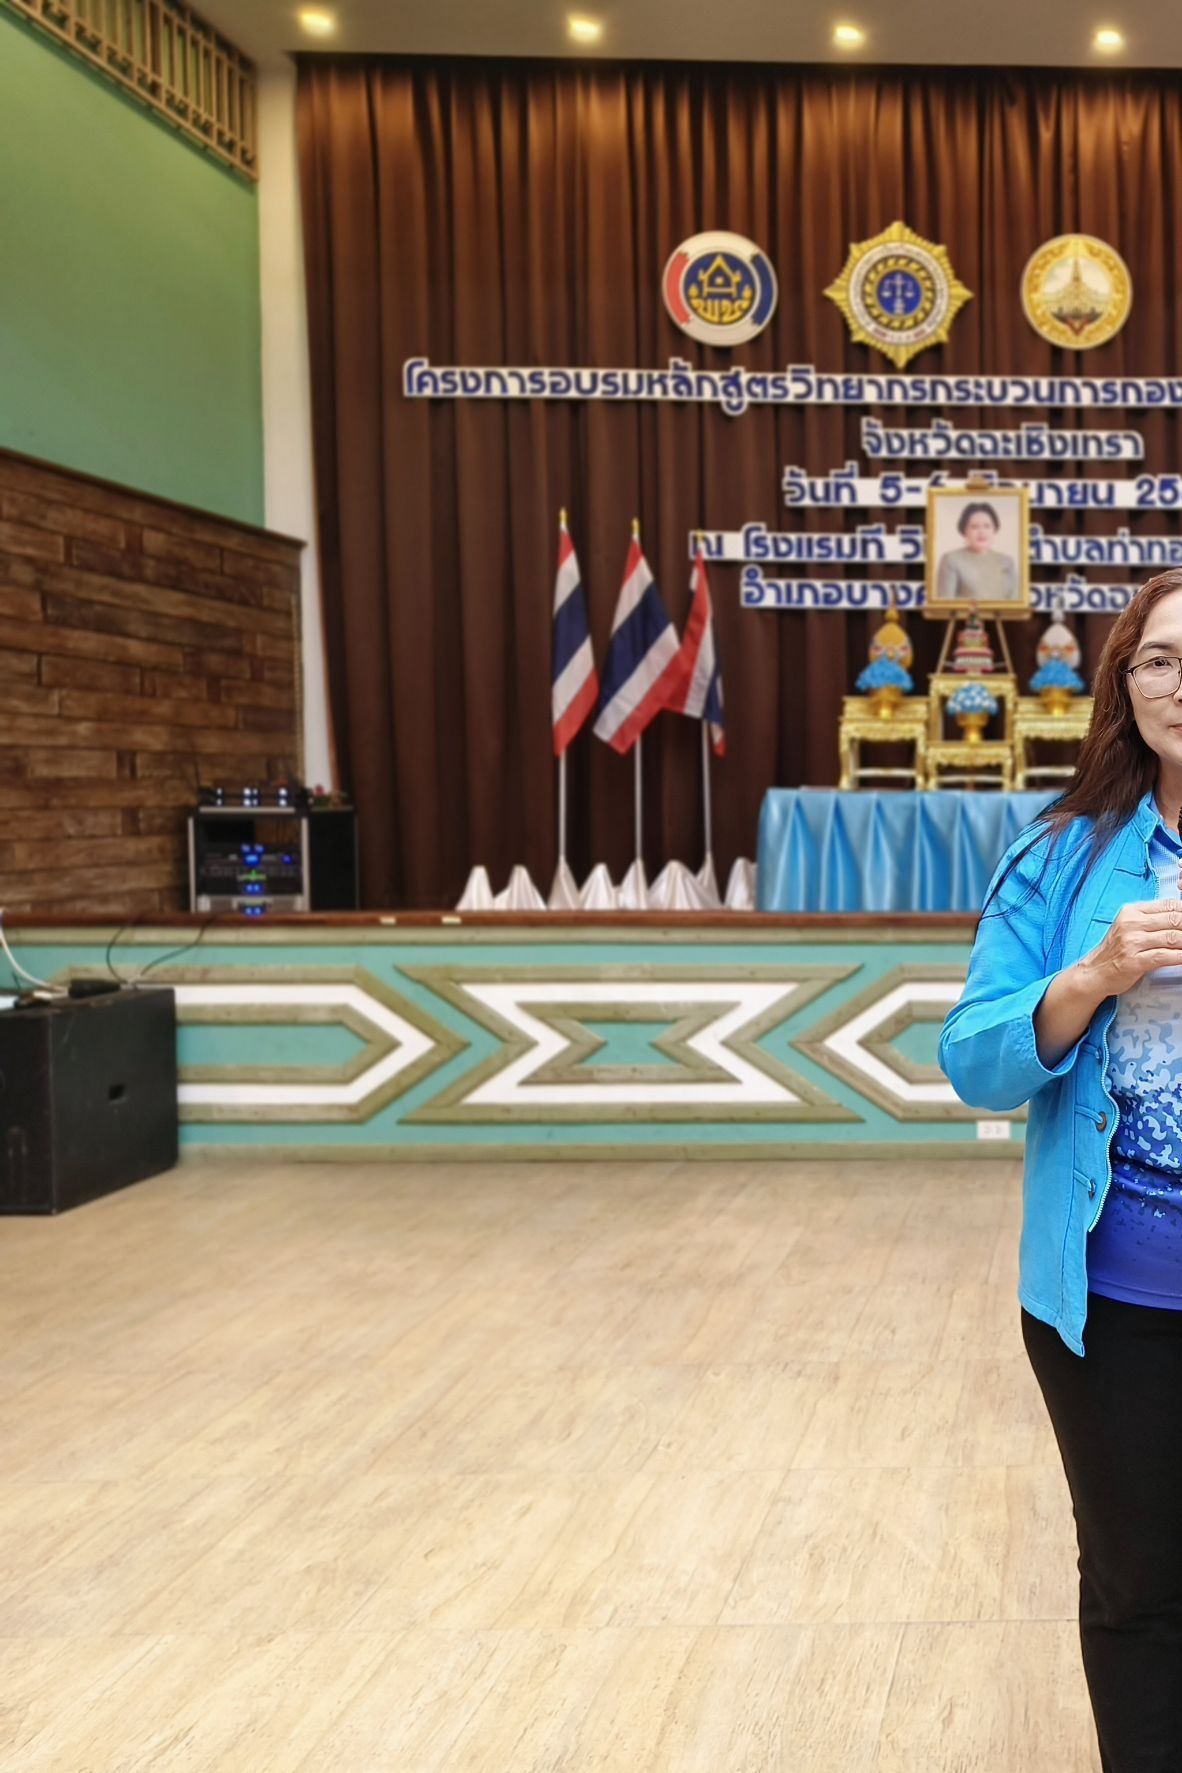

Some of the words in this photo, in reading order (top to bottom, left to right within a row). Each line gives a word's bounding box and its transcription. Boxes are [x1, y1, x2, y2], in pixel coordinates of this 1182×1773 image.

[864, 419, 1142, 455] จังหวัดฉะเชิงเทรา
[785, 464, 857, 503] วันที่
